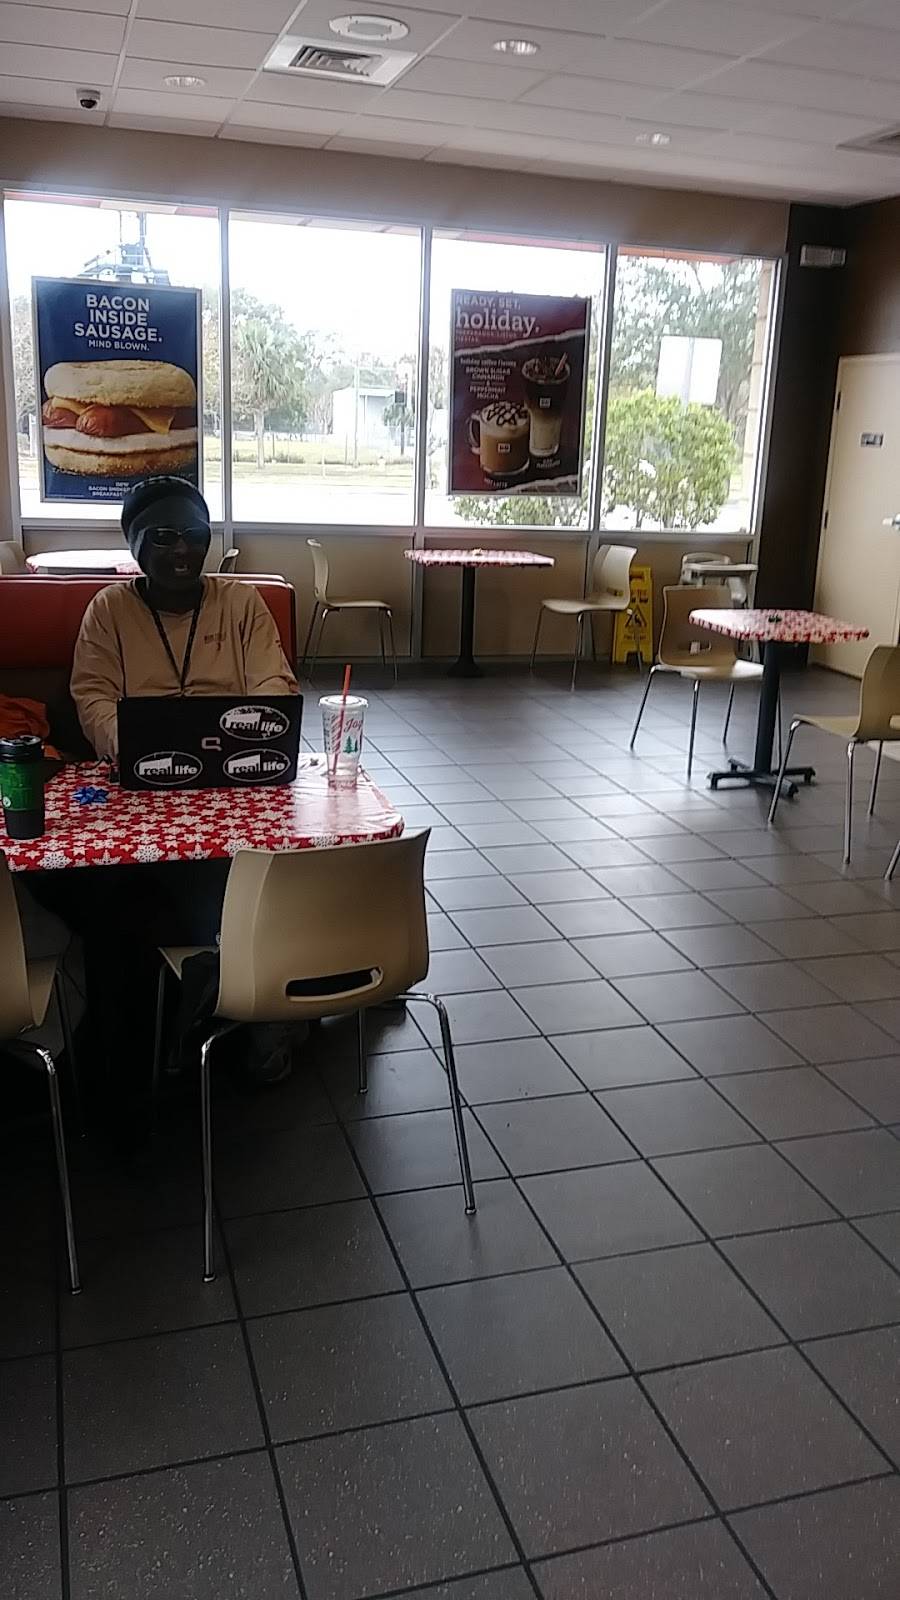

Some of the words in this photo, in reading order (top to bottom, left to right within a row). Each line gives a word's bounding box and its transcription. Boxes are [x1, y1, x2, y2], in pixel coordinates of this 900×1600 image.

[86, 294, 150, 312] BACON
[89, 309, 148, 326] INSIDE
[456, 305, 540, 338] holiday.
[74, 322, 162, 342] SAUSAGE.
[88, 340, 112, 348] MIND
[114, 341, 150, 351] BLOWN.
[465, 366, 489, 374] BROWN
[260, 720, 284, 732] life
[174, 764, 198, 775] life
[262, 760, 285, 771] life
